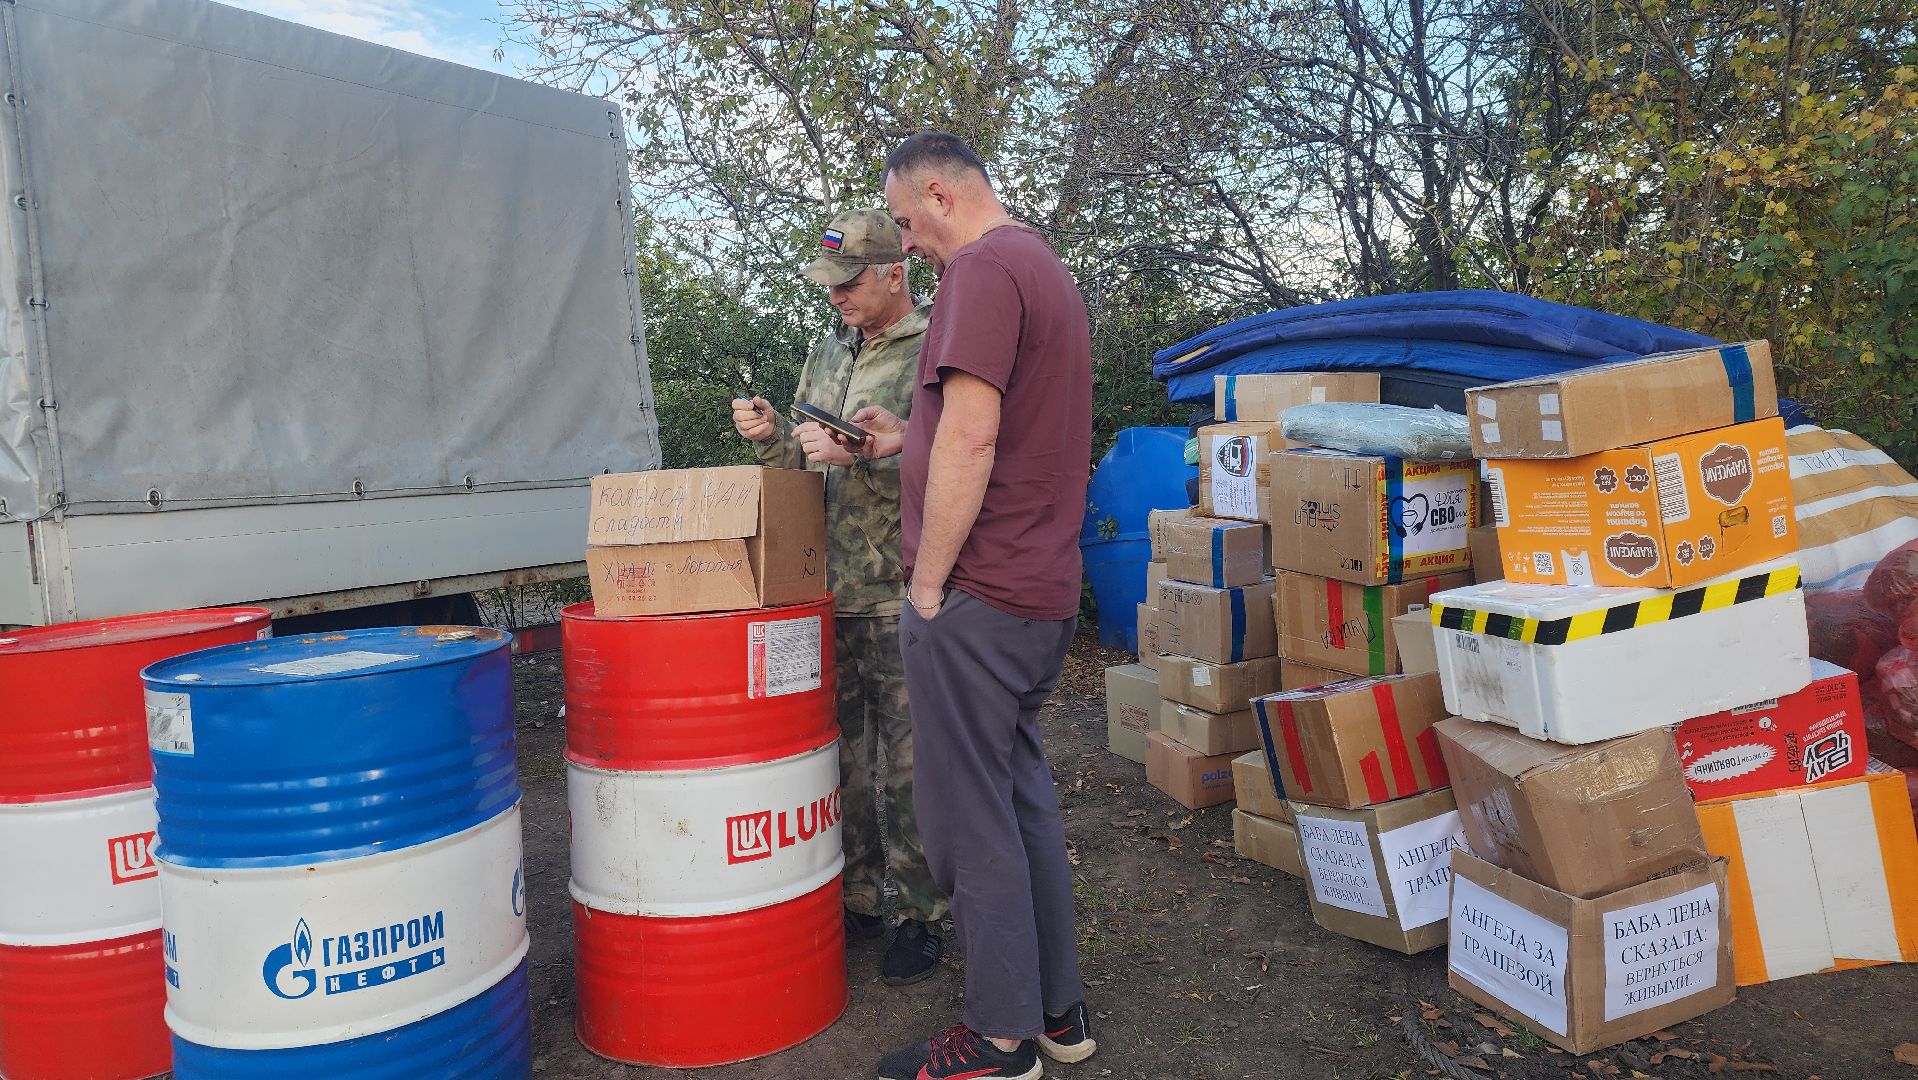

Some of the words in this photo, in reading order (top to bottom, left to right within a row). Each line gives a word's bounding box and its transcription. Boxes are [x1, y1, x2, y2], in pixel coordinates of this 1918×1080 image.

[1405, 464, 1440, 477] АКЦИЯ
[1705, 459, 1748, 483] КАРУСЕЛИ
[1420, 553, 1455, 567] АКЦИЯ
[1609, 545, 1653, 558] КАРУСЕЛИ
[1694, 756, 1741, 776] ГОВЯДИНЫ
[1808, 747, 1849, 781] ВАУ
[1302, 824, 1330, 842] БАБА
[1332, 828, 1365, 847] ЛЕНА
[1310, 846, 1367, 870] СКАЗАЛА:
[1397, 834, 1461, 870] АНГЕЛА
[1318, 867, 1369, 889] ВЕРНУТЬСЯ
[1613, 911, 1662, 940] БАБА
[1666, 898, 1713, 927] ЛЕНА
[323, 910, 445, 967] ГАЗПРОМ
[1460, 903, 1528, 954] АНГЕЛА
[1532, 940, 1557, 968] ЗА
[1621, 926, 1708, 966] СКАЗАЛА:
[328, 949, 445, 994] НЕФТЬ
[1461, 931, 1555, 997] ТРАПЕЗОЙ
[1625, 950, 1704, 986] ВЕРНУТЬСЯ
[1624, 977, 1701, 1007] ЖИВЫМИ...
